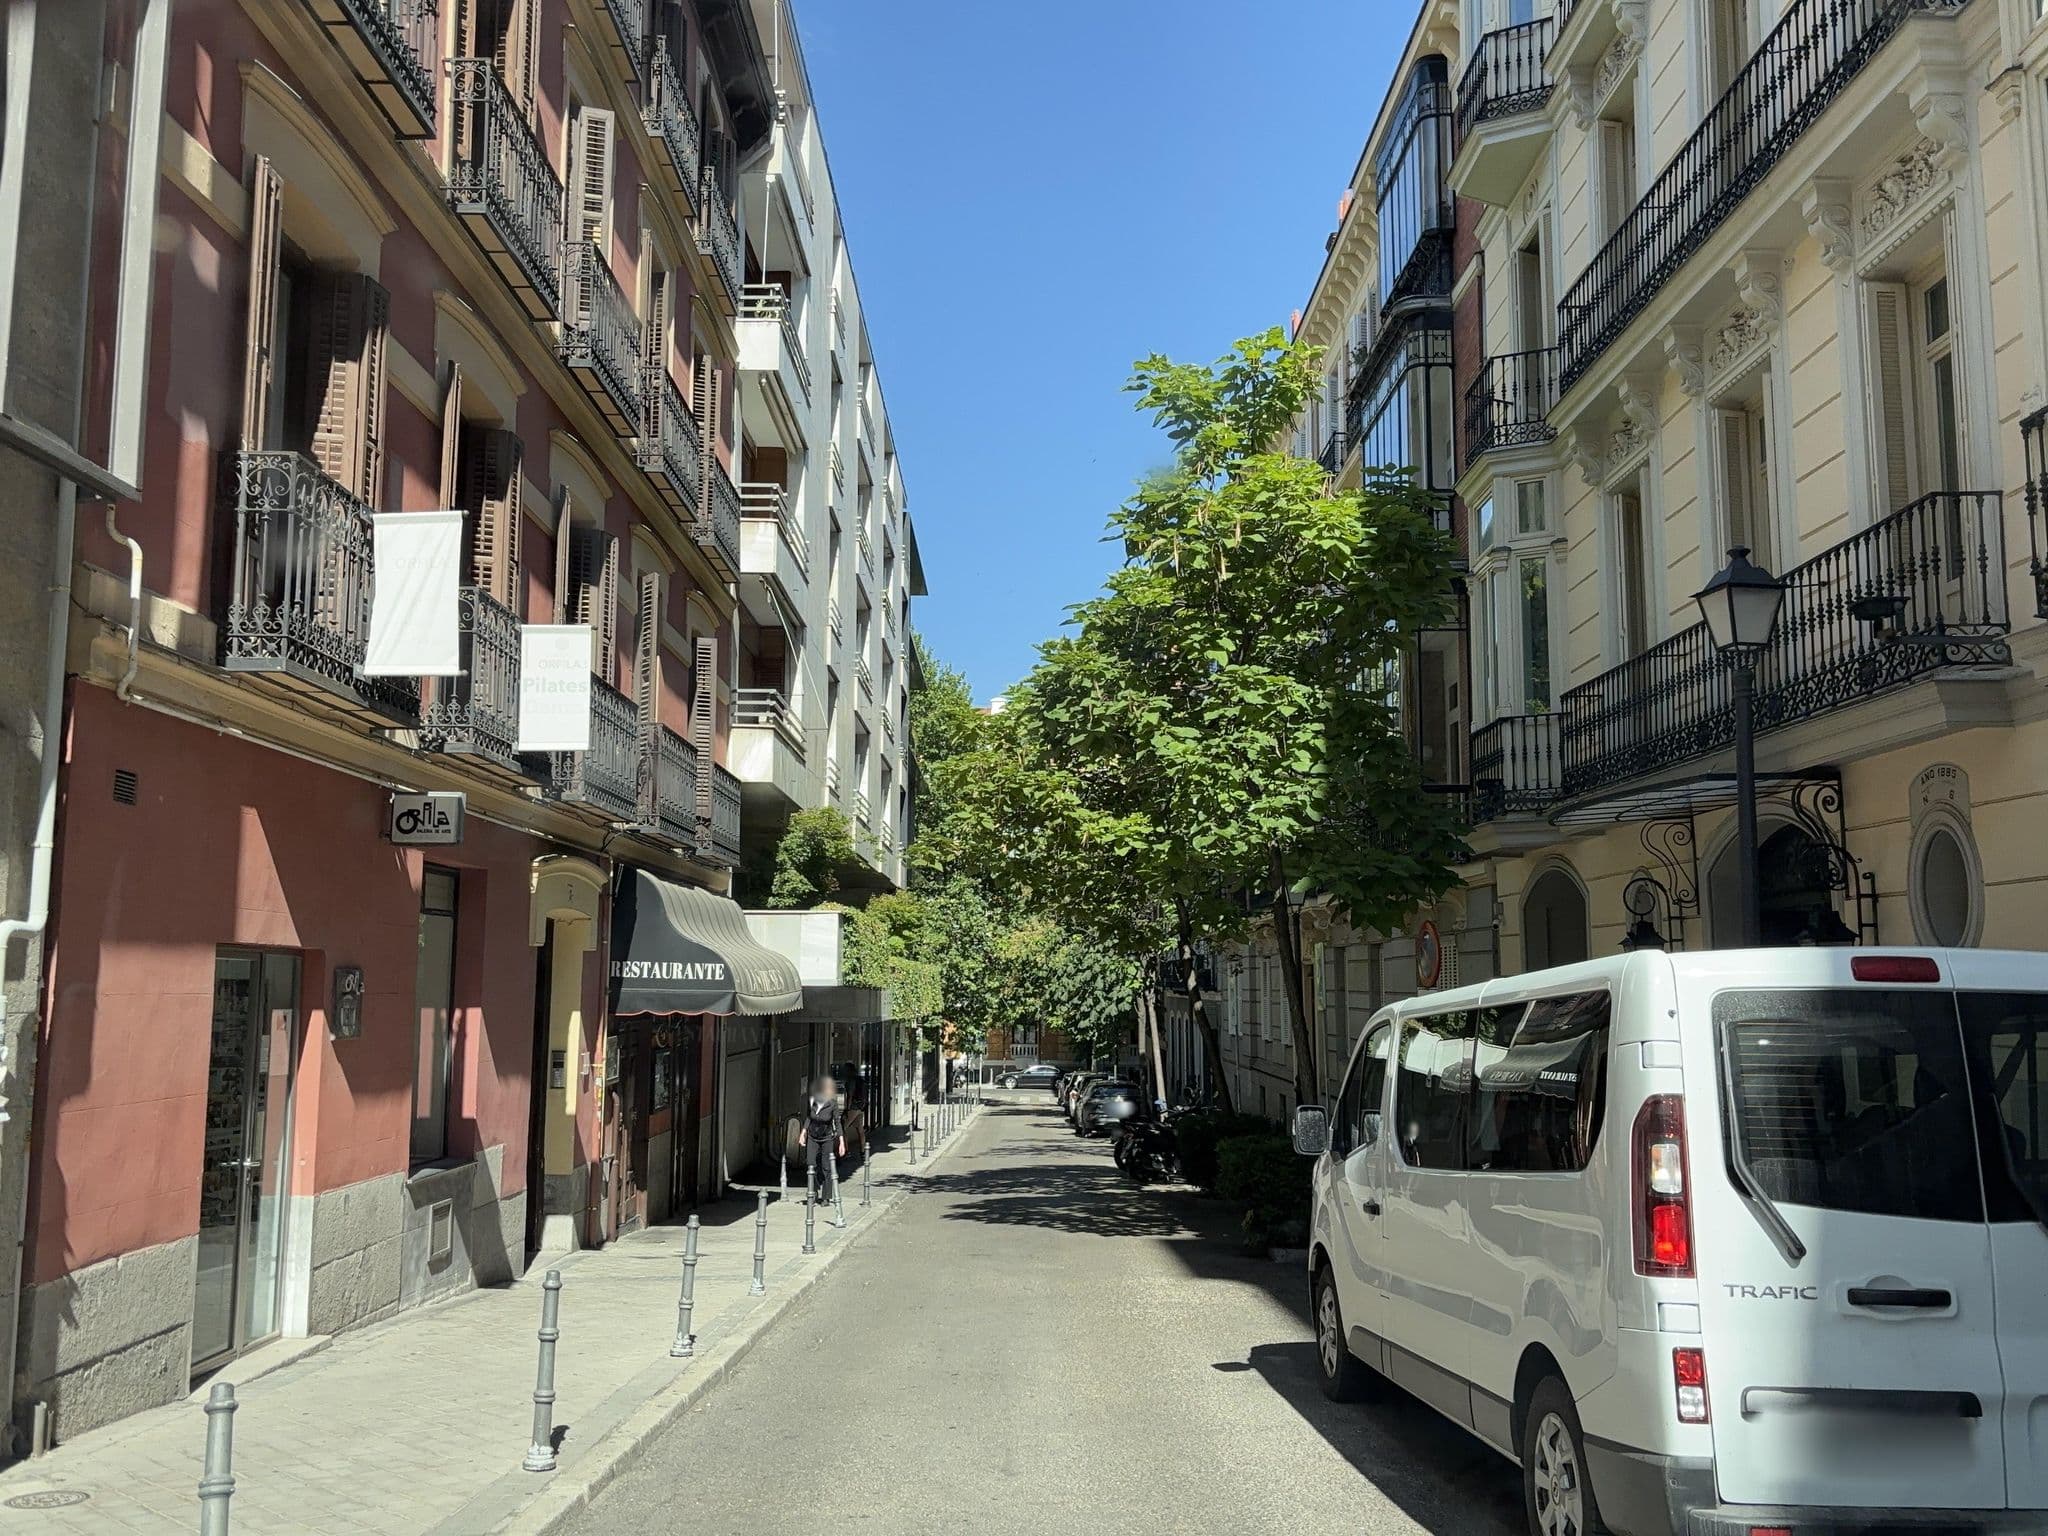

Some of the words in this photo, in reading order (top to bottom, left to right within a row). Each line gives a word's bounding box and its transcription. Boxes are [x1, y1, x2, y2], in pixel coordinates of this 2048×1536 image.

[523, 676, 588, 694] Pilates
[1937, 768, 1956, 778] 1885
[610, 960, 725, 981] RESTAURANTE
[1722, 1282, 1818, 1300] TRAFIC
